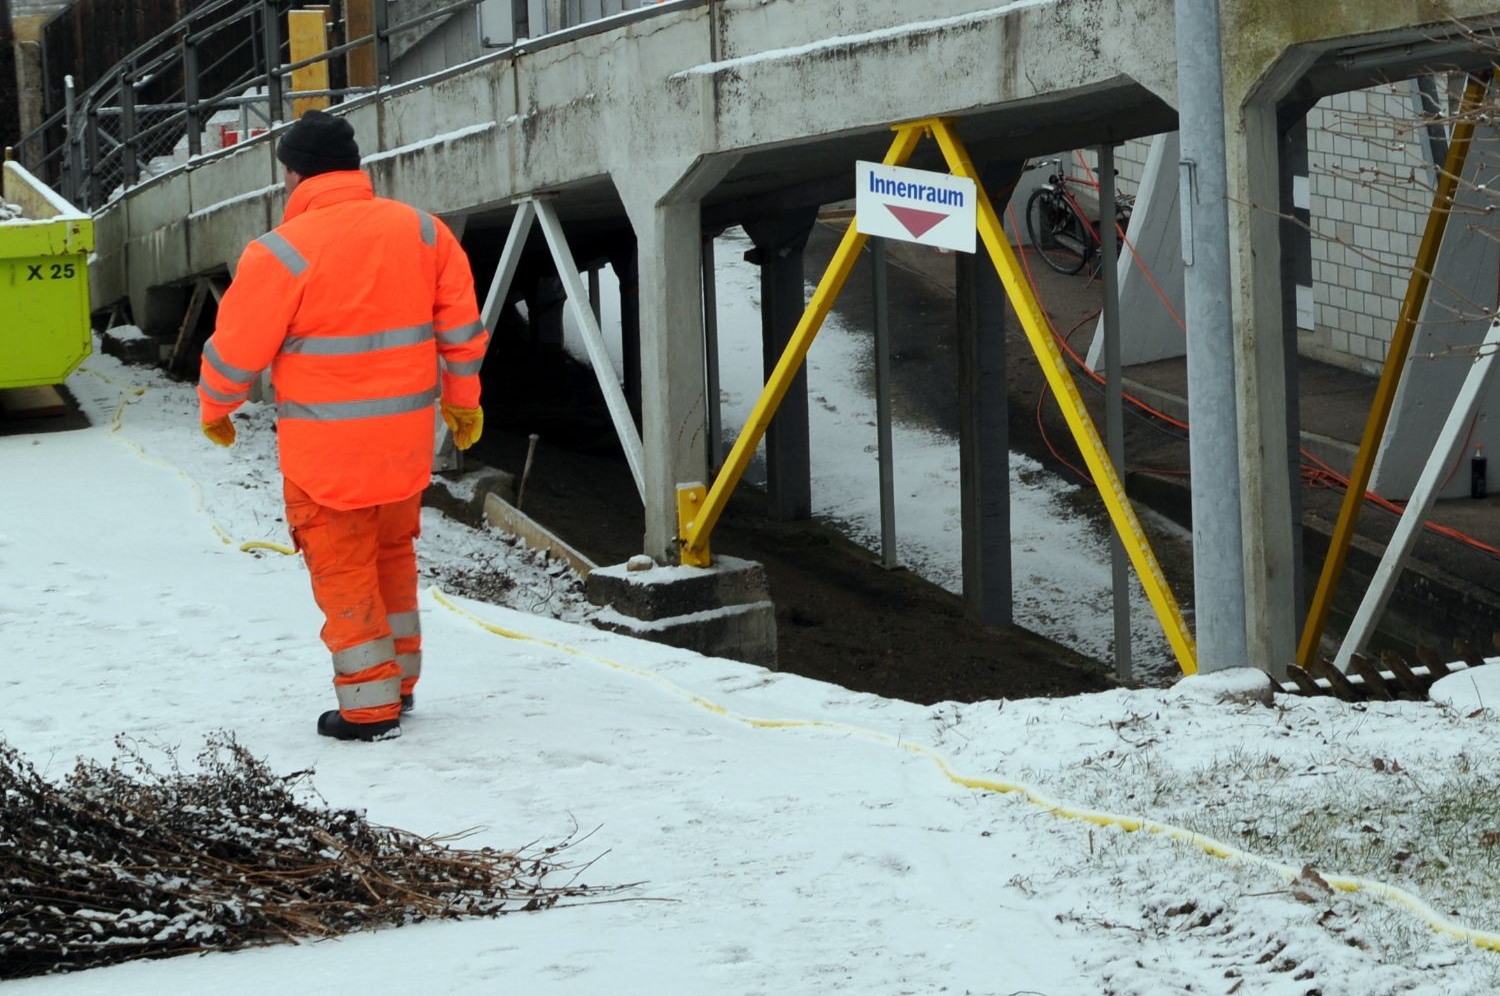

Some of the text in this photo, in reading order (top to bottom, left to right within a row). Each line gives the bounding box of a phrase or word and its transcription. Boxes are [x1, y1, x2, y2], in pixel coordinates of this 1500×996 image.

[869, 170, 964, 207] Innenraum
[27, 263, 75, 281] X 25
